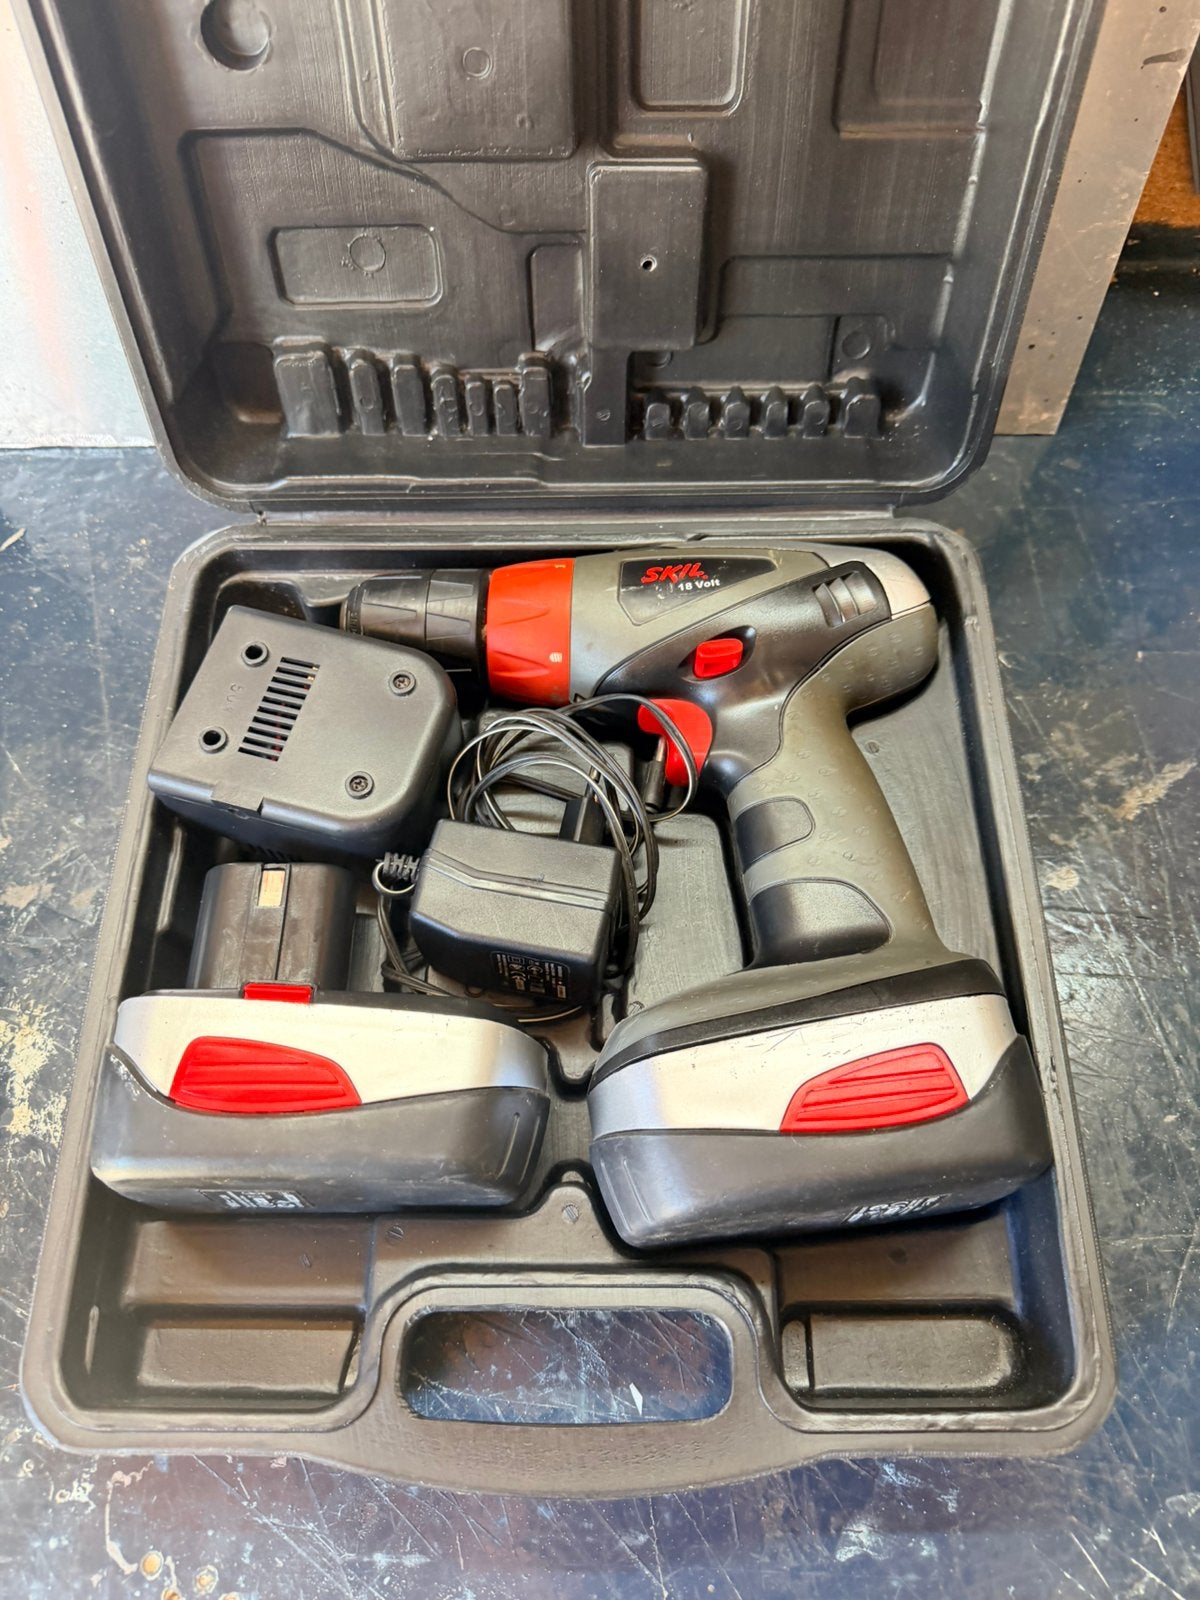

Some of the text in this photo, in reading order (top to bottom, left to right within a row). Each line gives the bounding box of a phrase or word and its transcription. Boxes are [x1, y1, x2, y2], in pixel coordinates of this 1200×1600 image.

[640, 562, 705, 584] SKIL
[678, 578, 721, 592] 18 Volt
